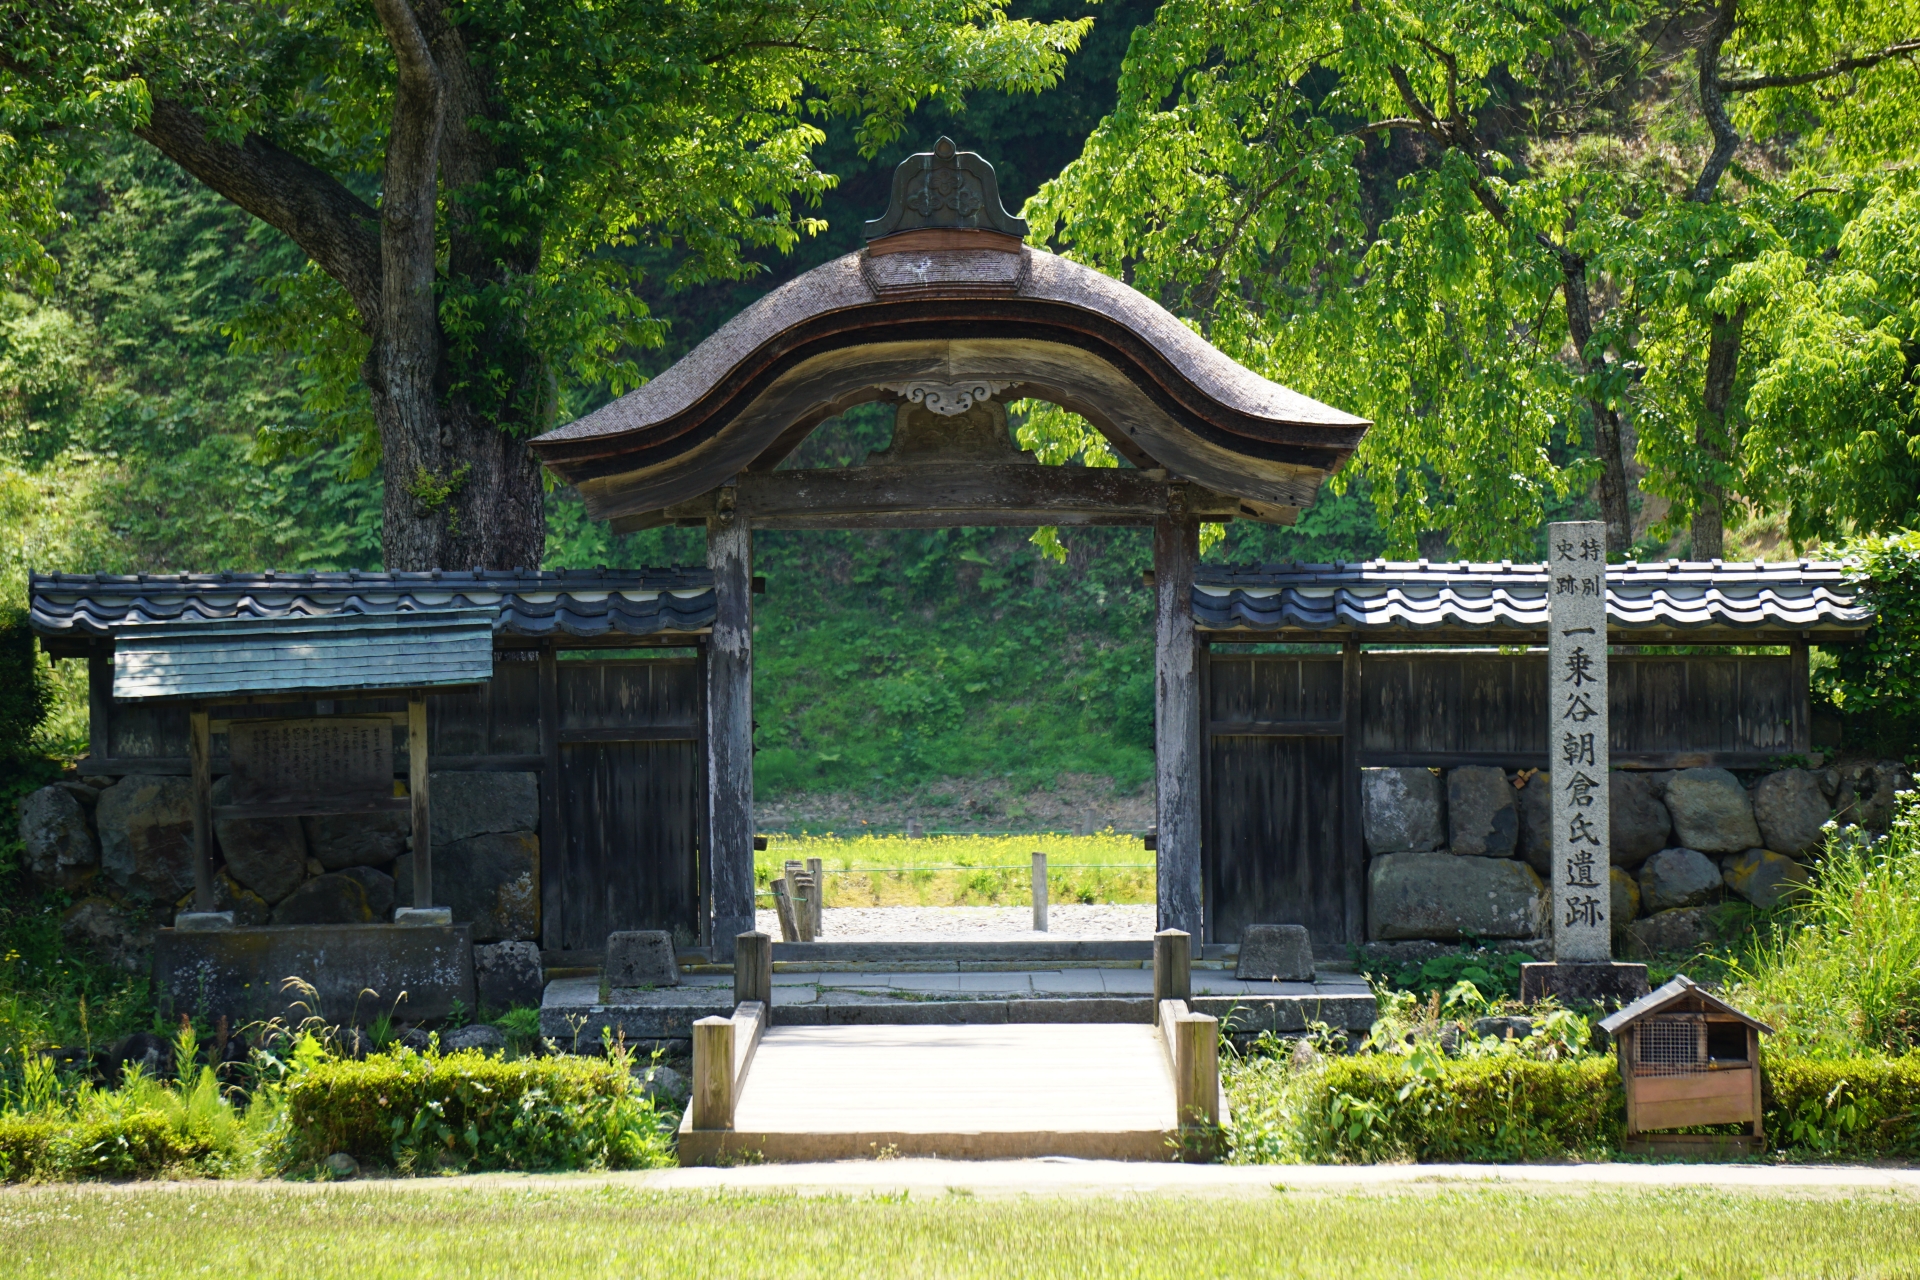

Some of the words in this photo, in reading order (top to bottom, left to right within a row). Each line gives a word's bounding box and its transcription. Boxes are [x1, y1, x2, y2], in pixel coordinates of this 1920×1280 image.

[1556, 539, 1577, 595] 史跡
[1579, 538, 1601, 597] 特別
[1561, 627, 1604, 928] 一乗谷朝倉氏遺跡
